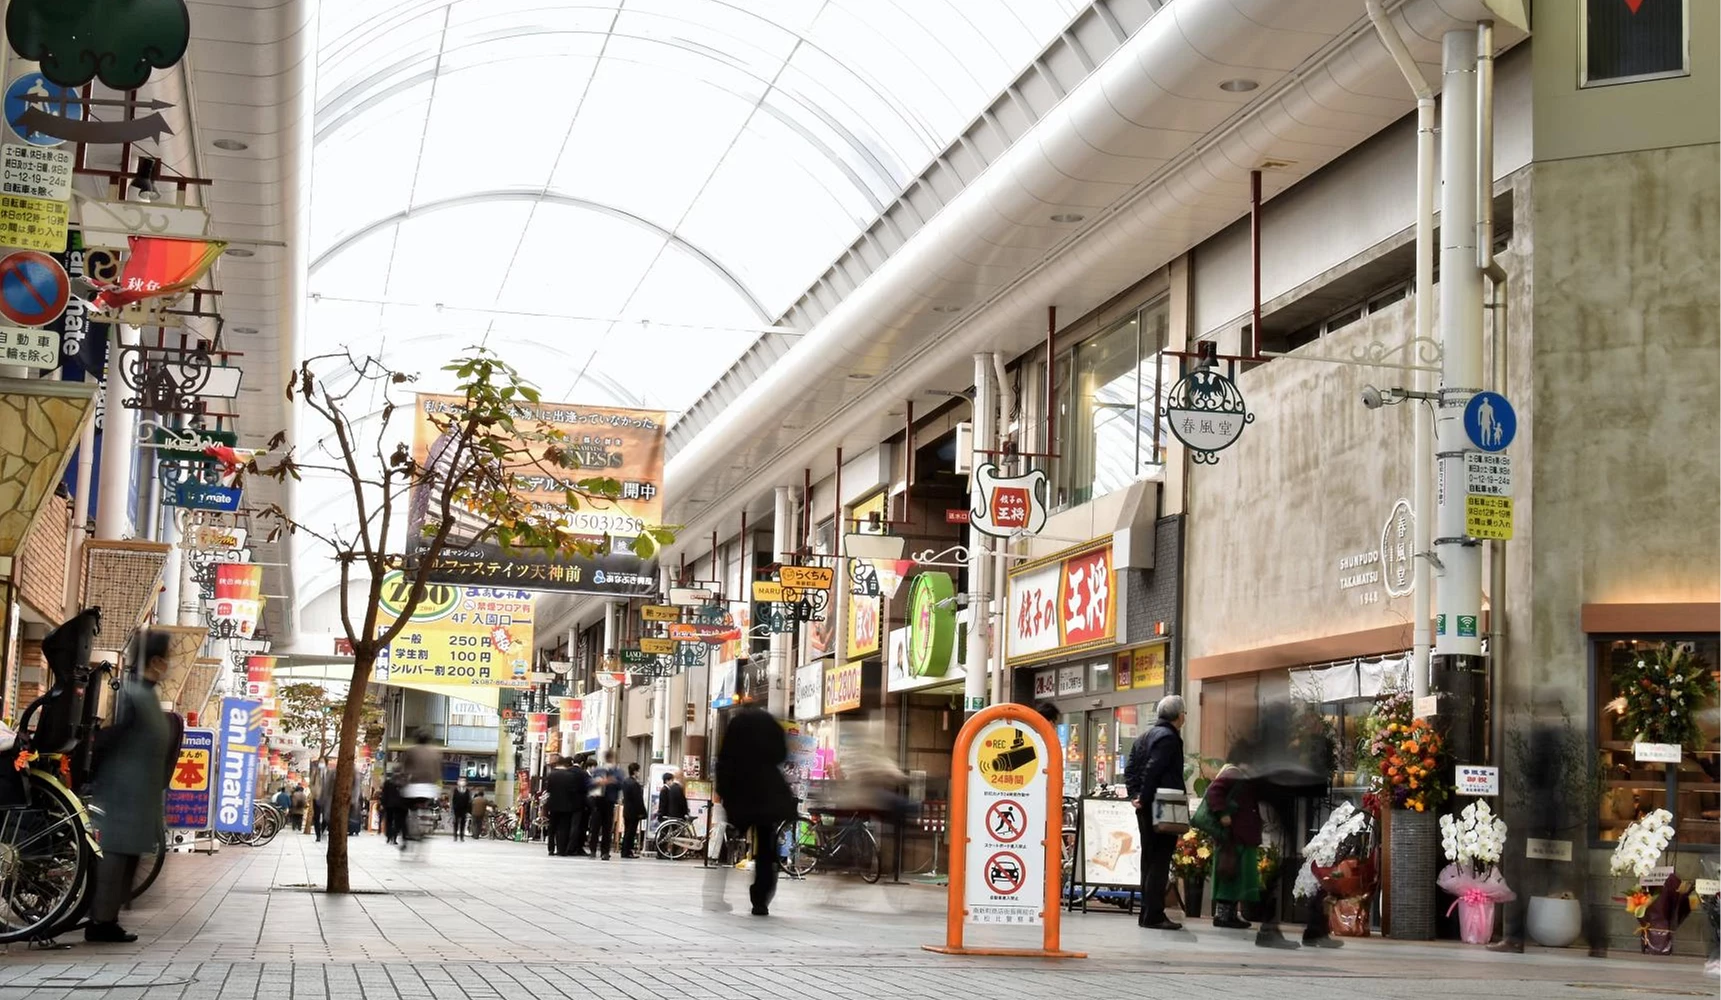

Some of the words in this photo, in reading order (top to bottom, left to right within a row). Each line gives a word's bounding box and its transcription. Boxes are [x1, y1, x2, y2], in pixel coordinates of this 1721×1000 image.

[3, 182, 53, 197] 自転車を除く
[1182, 417, 1232, 436] 春風堂
[1000, 495, 1024, 504] 餃子の
[997, 507, 1026, 521] 王将
[1469, 528, 1504, 537] できません
[1340, 551, 1378, 570] SHUNPUDO
[796, 570, 829, 580] らくちん
[1340, 571, 1378, 589] TAKAMATSU
[1066, 556, 1108, 635] 王将
[451, 614, 467, 624] 4F
[472, 614, 511, 625] 入園口
[1018, 588, 1055, 640] 餃子の
[400, 633, 421, 644] 一般
[395, 649, 428, 660] 学生割
[391, 664, 445, 676] シルバー割
[993, 739, 1006, 749] REC
[219, 707, 257, 825] animate
[174, 759, 205, 788] 本
[991, 774, 1024, 785] 24時間
